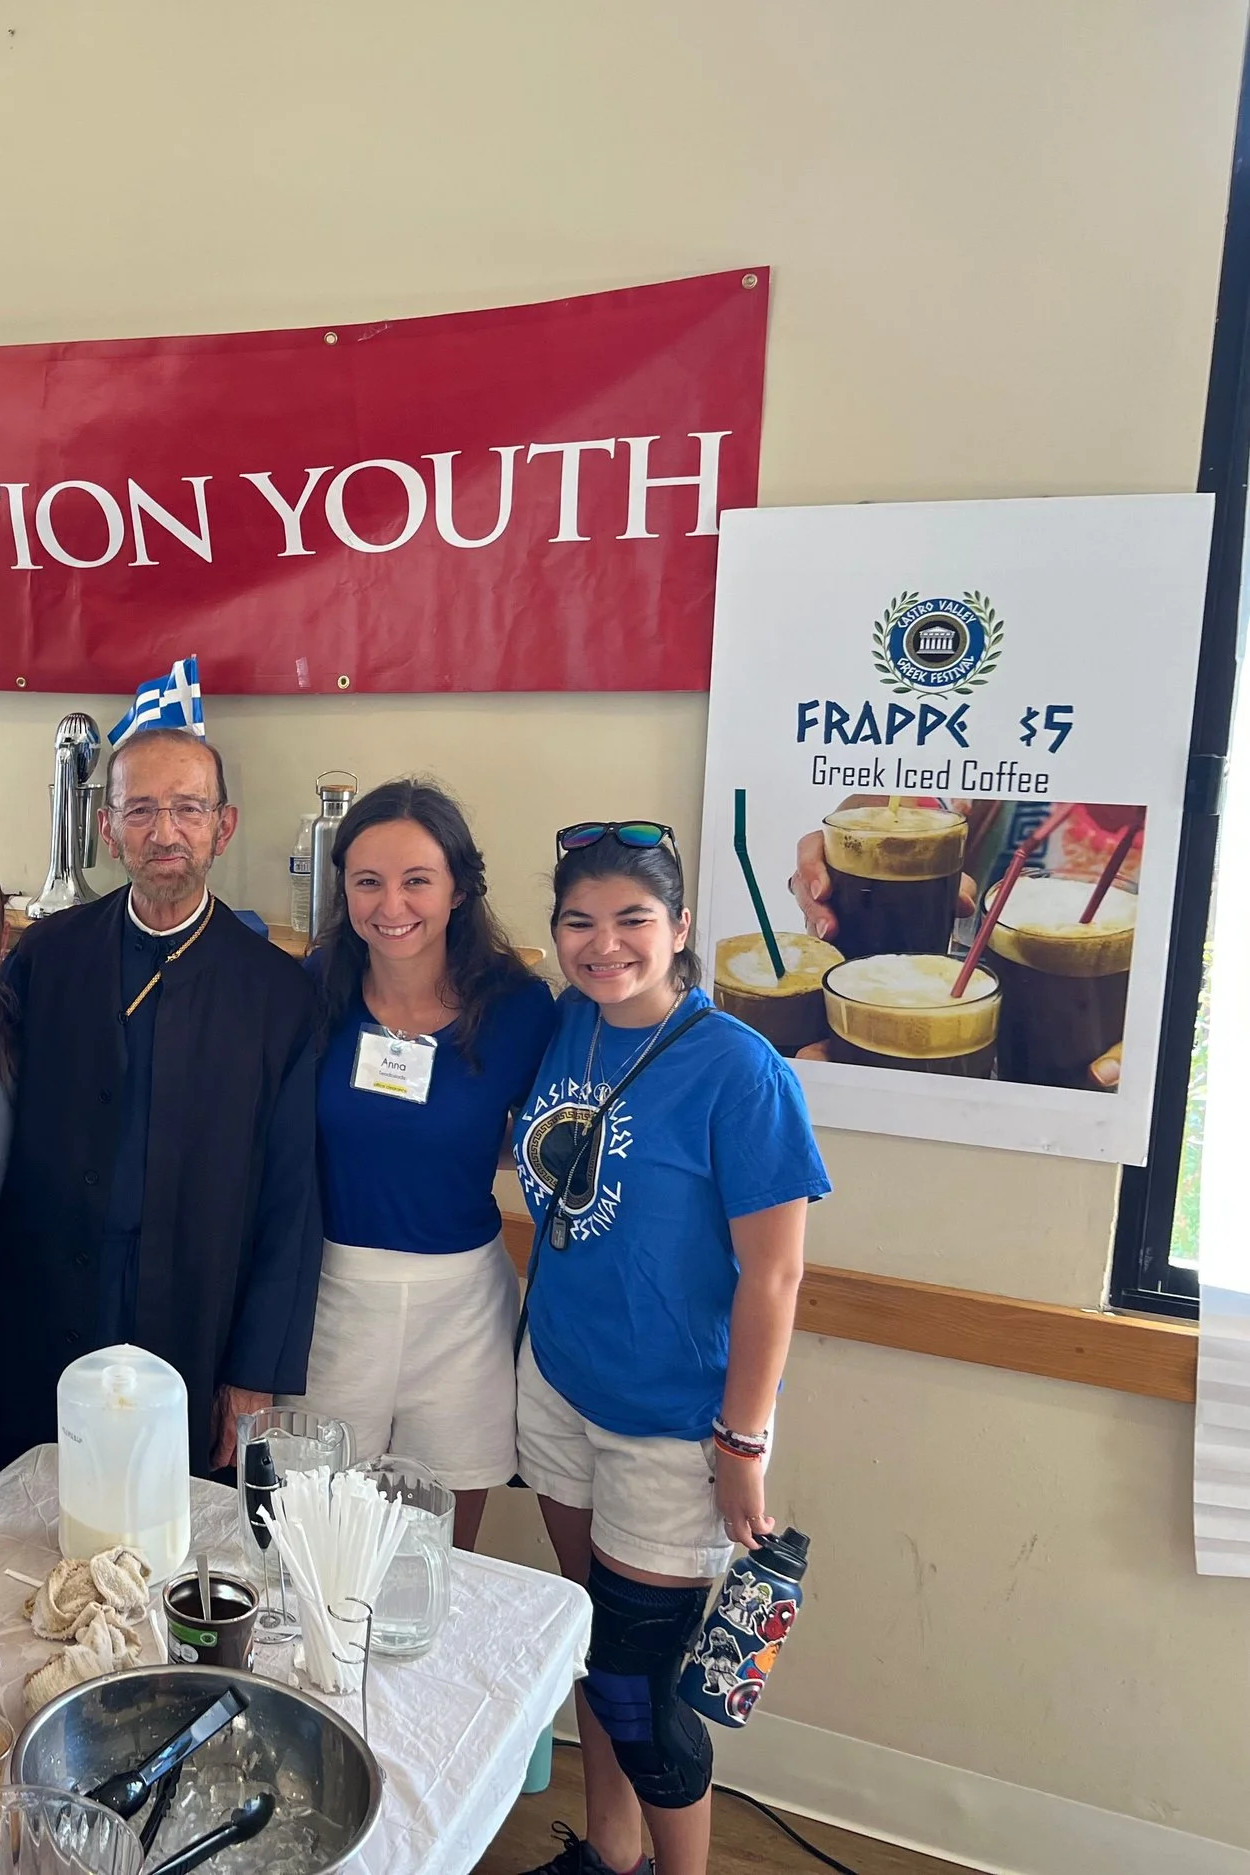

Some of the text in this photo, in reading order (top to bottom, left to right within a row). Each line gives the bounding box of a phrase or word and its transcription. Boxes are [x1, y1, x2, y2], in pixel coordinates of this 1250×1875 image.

[238, 431, 733, 556] YOUTH
[897, 600, 977, 628] CASTRO VALLEY
[896, 655, 975, 683] GREEK FESTIVAL
[1020, 704, 1074, 754] $5
[812, 755, 1049, 793] Greek Iced Coffee
[381, 1058, 406, 1071] Anna
[569, 1181, 622, 1241] ESTIVAL
